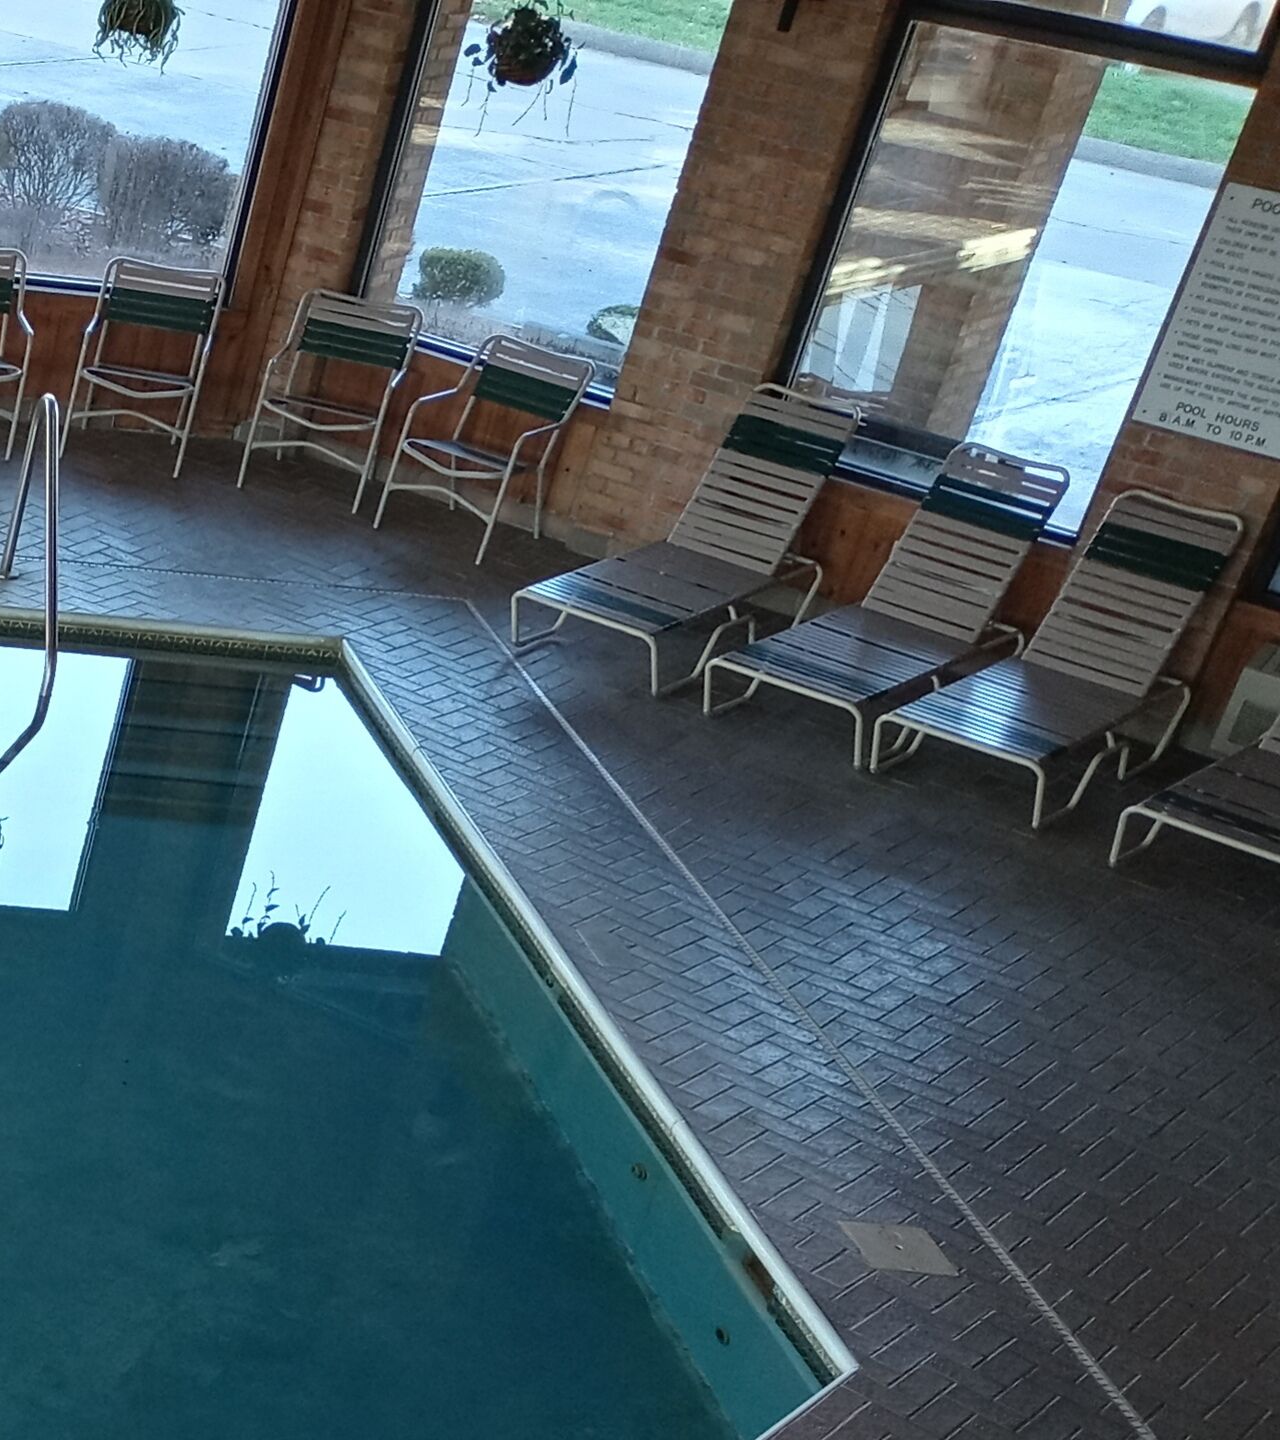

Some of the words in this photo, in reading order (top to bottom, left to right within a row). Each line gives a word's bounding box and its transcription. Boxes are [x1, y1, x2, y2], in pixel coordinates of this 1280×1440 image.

[1159, 412, 1168, 422] 8
[1206, 422, 1221, 435] TO
[1229, 430, 1243, 441] 10
[1175, 401, 1206, 419] POOL
[1214, 412, 1260, 432] HOURS
